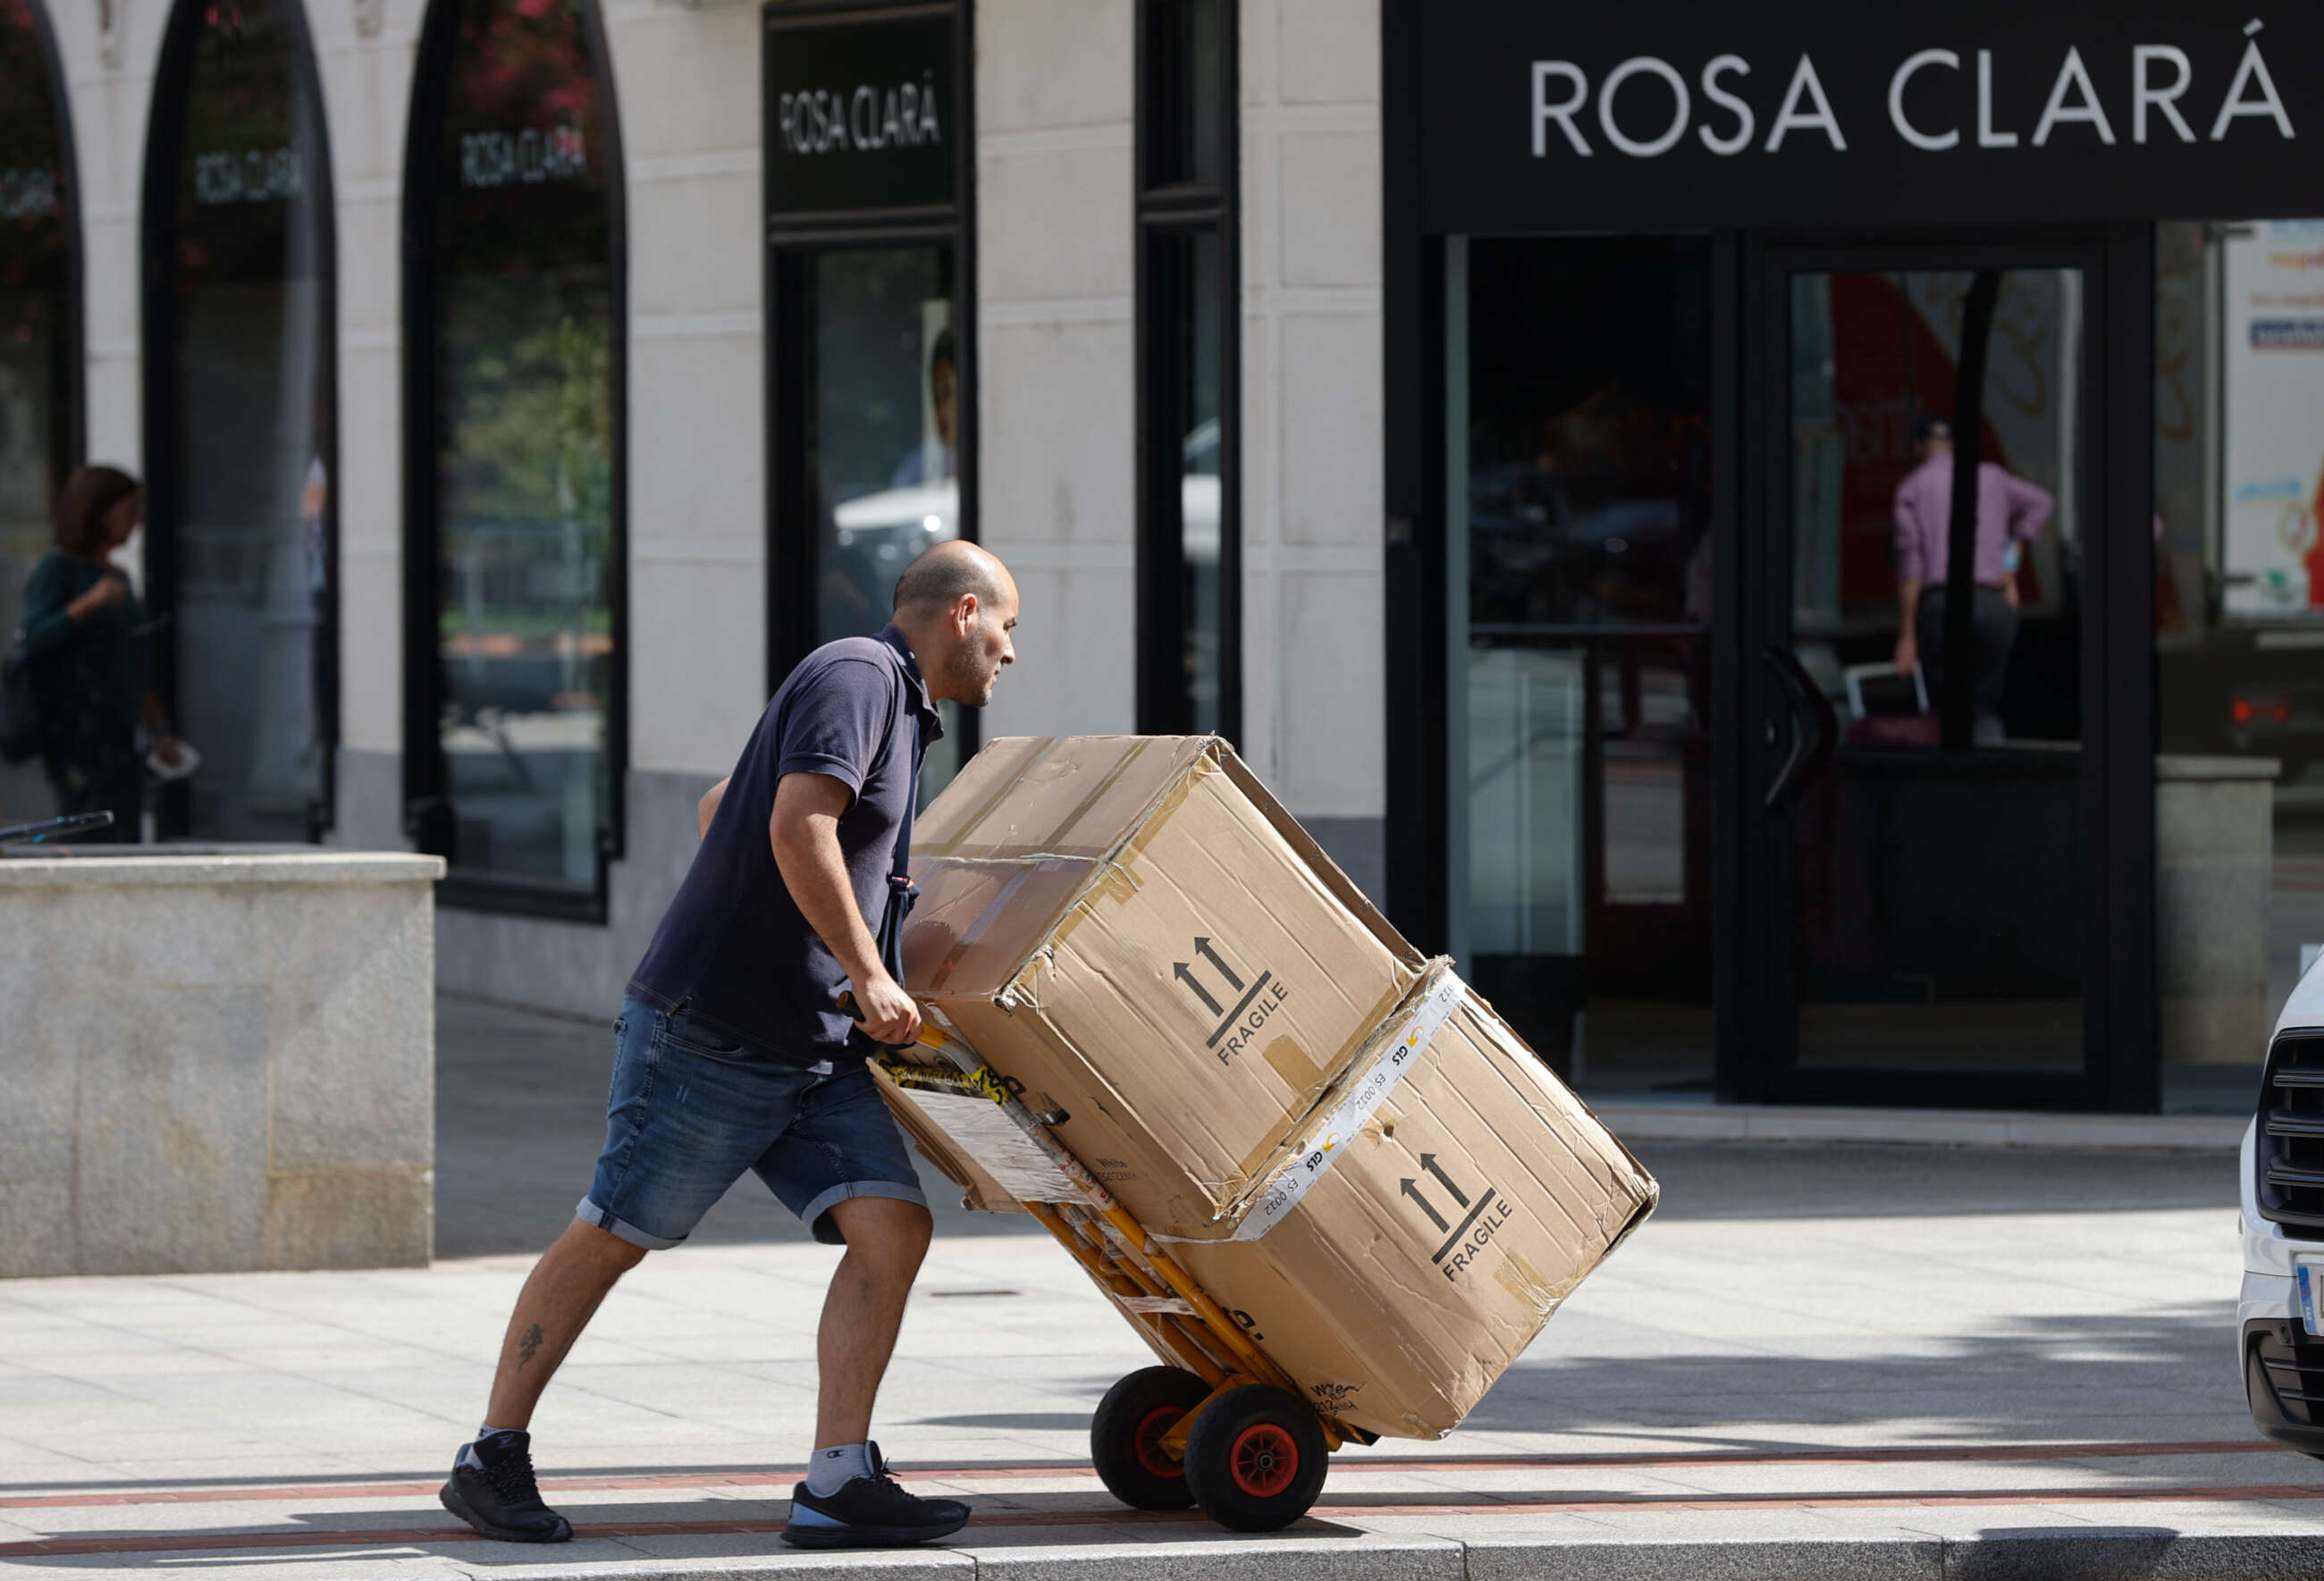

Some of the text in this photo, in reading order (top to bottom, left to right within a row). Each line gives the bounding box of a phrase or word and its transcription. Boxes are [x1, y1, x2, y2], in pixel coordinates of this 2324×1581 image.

[1531, 17, 2296, 158] ROSA CLARÁ
[779, 88, 848, 154] ROSA
[1217, 981, 1289, 1067] FRAGILE
[1392, 1046, 1409, 1066] GLS
[1355, 1072, 1386, 1110] ES 0012
[1306, 1151, 1323, 1173] GLS
[1263, 1178, 1299, 1216] ES 0012
[1442, 1198, 1513, 1282] FRAGILE
